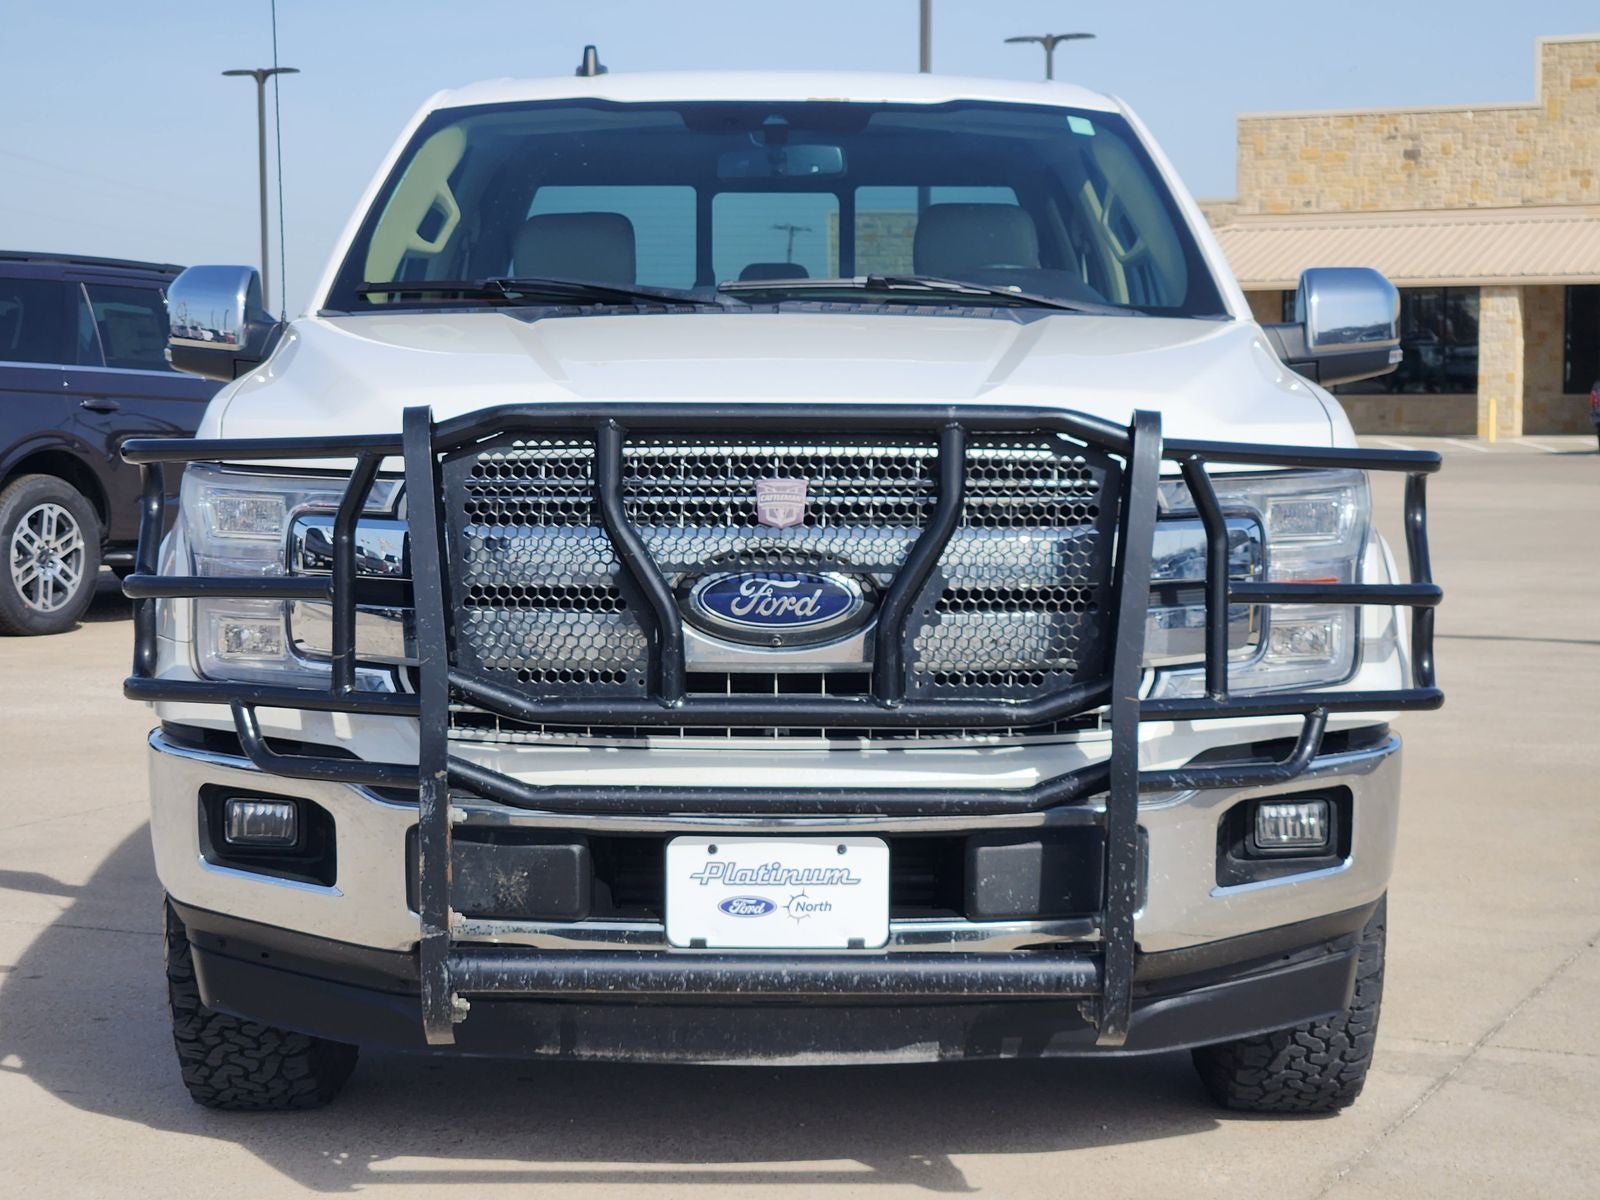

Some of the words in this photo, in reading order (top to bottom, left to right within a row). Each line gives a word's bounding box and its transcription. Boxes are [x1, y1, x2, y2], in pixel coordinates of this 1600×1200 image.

[731, 578, 823, 616] Ford
[690, 861, 861, 886] Platinum
[728, 899, 765, 915] Ford
[795, 901, 832, 912] North
